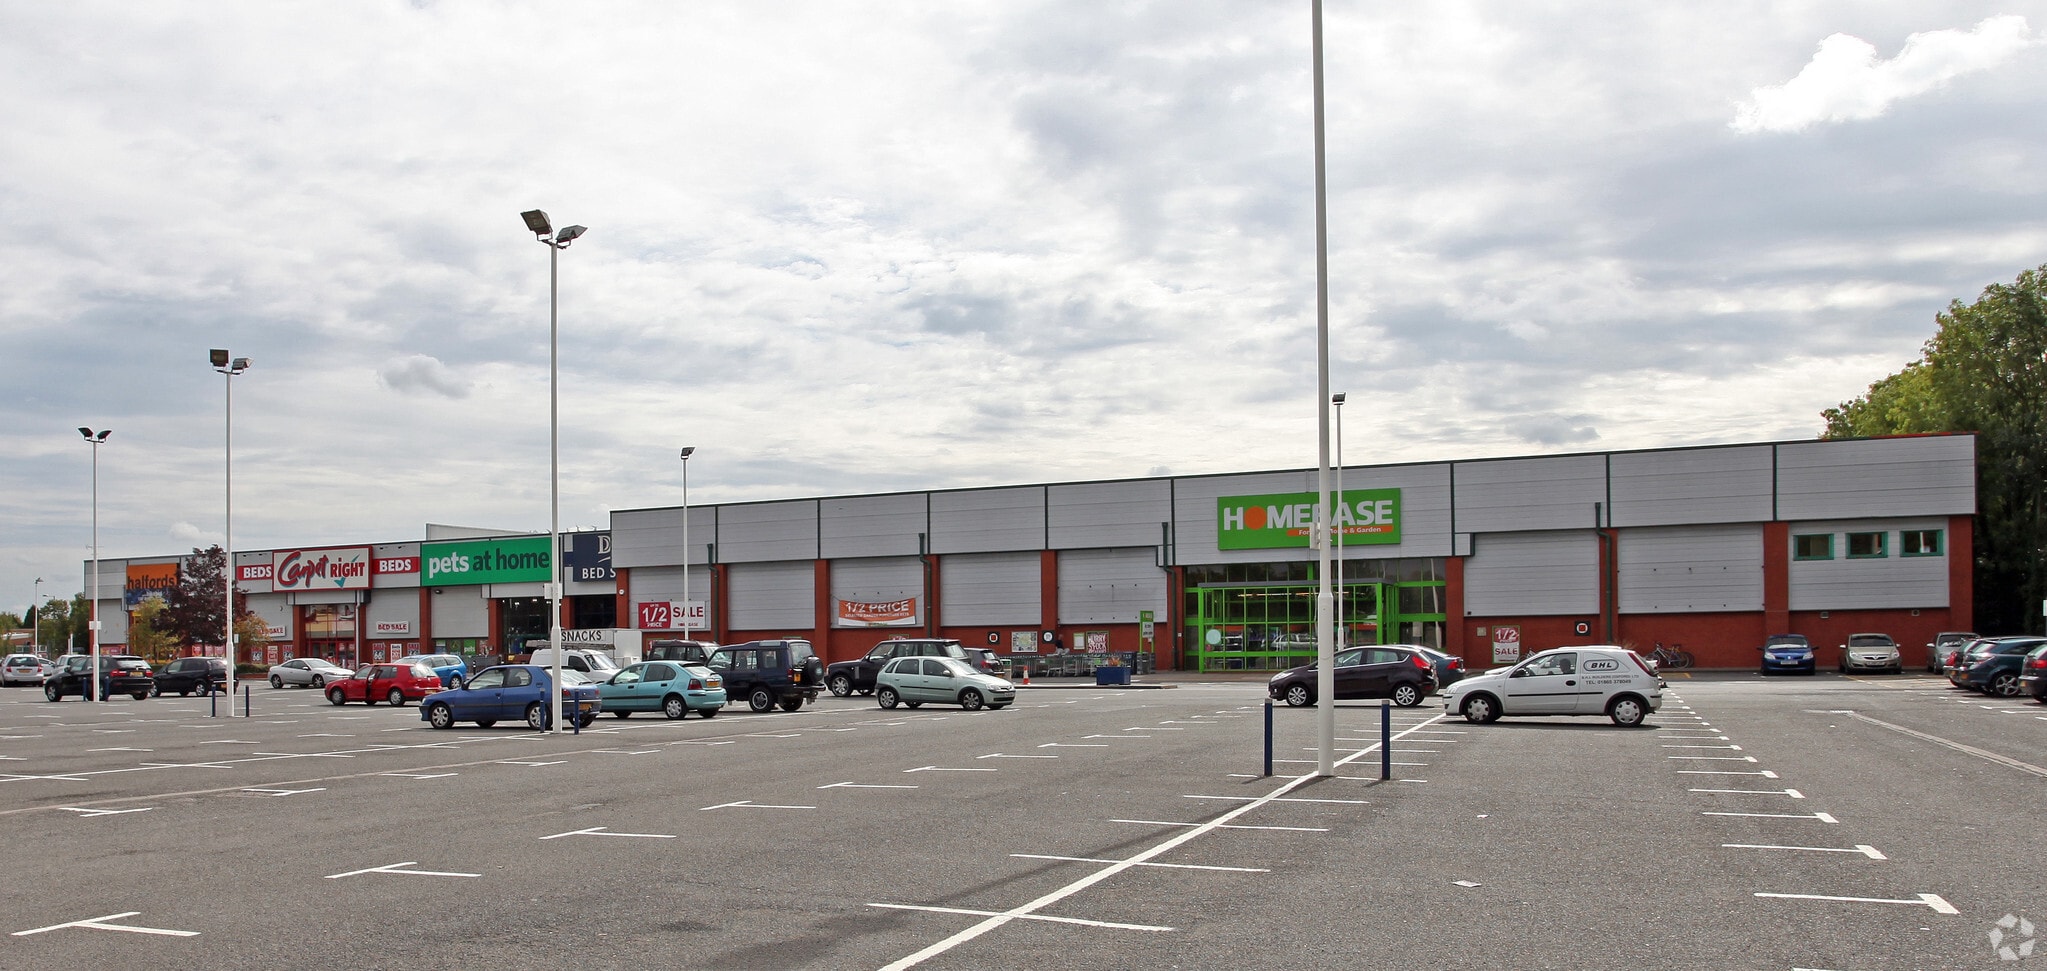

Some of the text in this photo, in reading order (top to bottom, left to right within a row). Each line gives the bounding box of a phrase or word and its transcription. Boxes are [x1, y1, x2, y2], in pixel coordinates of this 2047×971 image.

[277, 550, 329, 588] Carpet
[379, 558, 412, 572] BEDS
[428, 547, 550, 579] pets at home
[243, 565, 272, 579] BEDS
[582, 567, 605, 579] BED
[127, 573, 175, 590] halfords
[845, 600, 909, 613] 1/2 PRICE
[642, 606, 704, 622] 1/2 SALE
[391, 623, 407, 631] SALE
[561, 630, 602, 642] SNACKS
[1495, 648, 1518, 656] SALE
